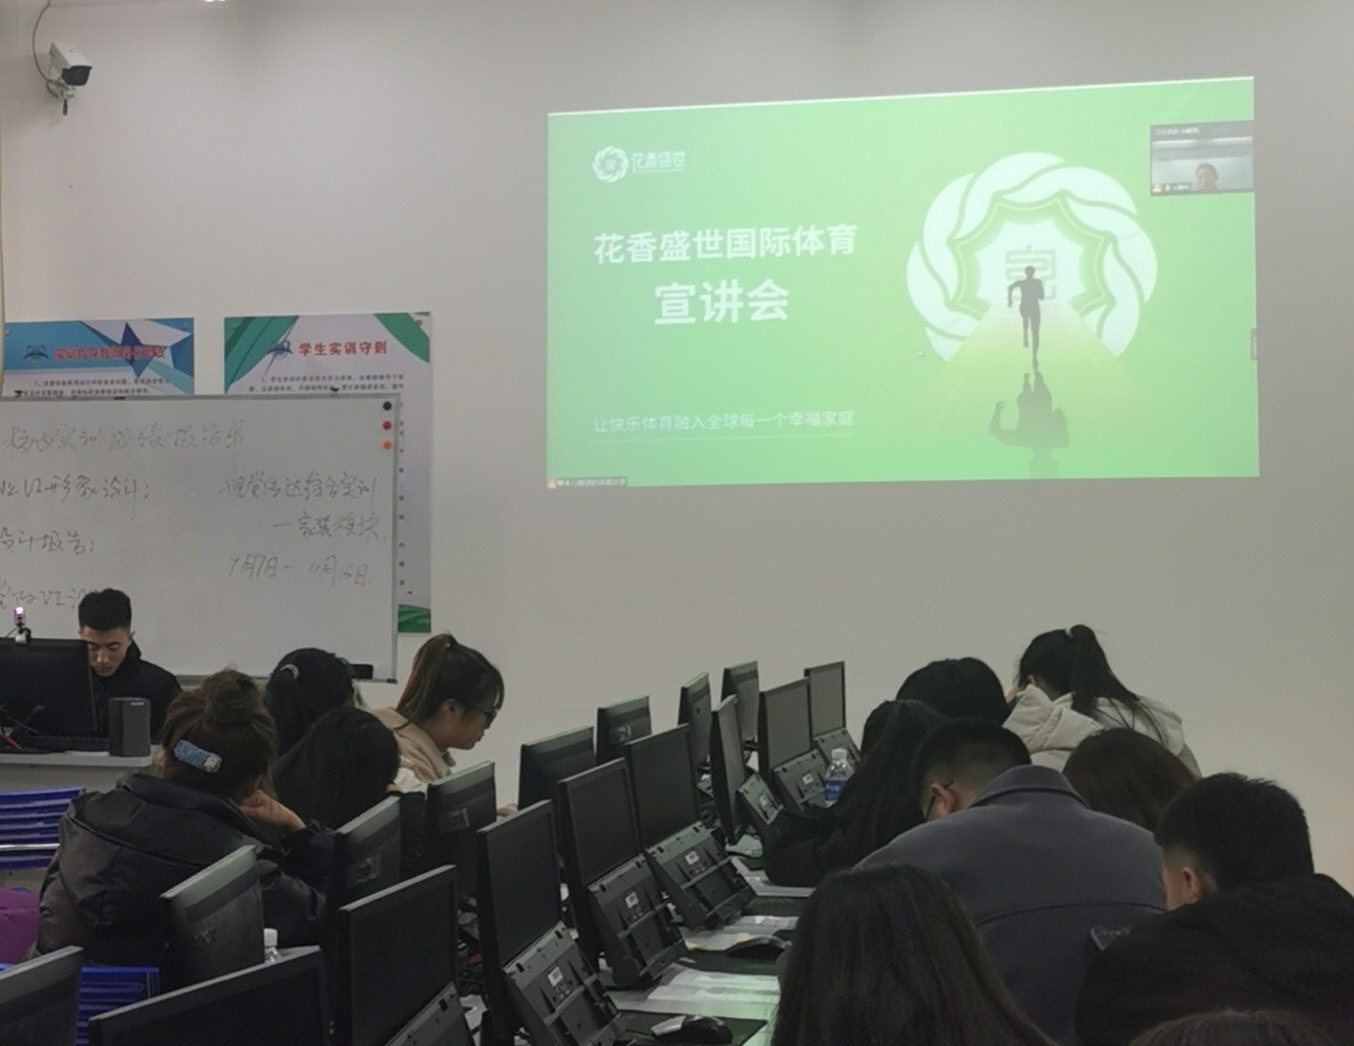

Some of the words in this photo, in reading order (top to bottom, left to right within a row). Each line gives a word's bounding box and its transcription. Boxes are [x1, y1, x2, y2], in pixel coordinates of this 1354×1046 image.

[593, 222, 858, 265] 花香盛世国际体育
[654, 278, 790, 325] 宣讲会
[298, 340, 388, 357] 学生实训守则
[594, 410, 855, 433] 让快乐体育融入全球每一个幸福家庭
